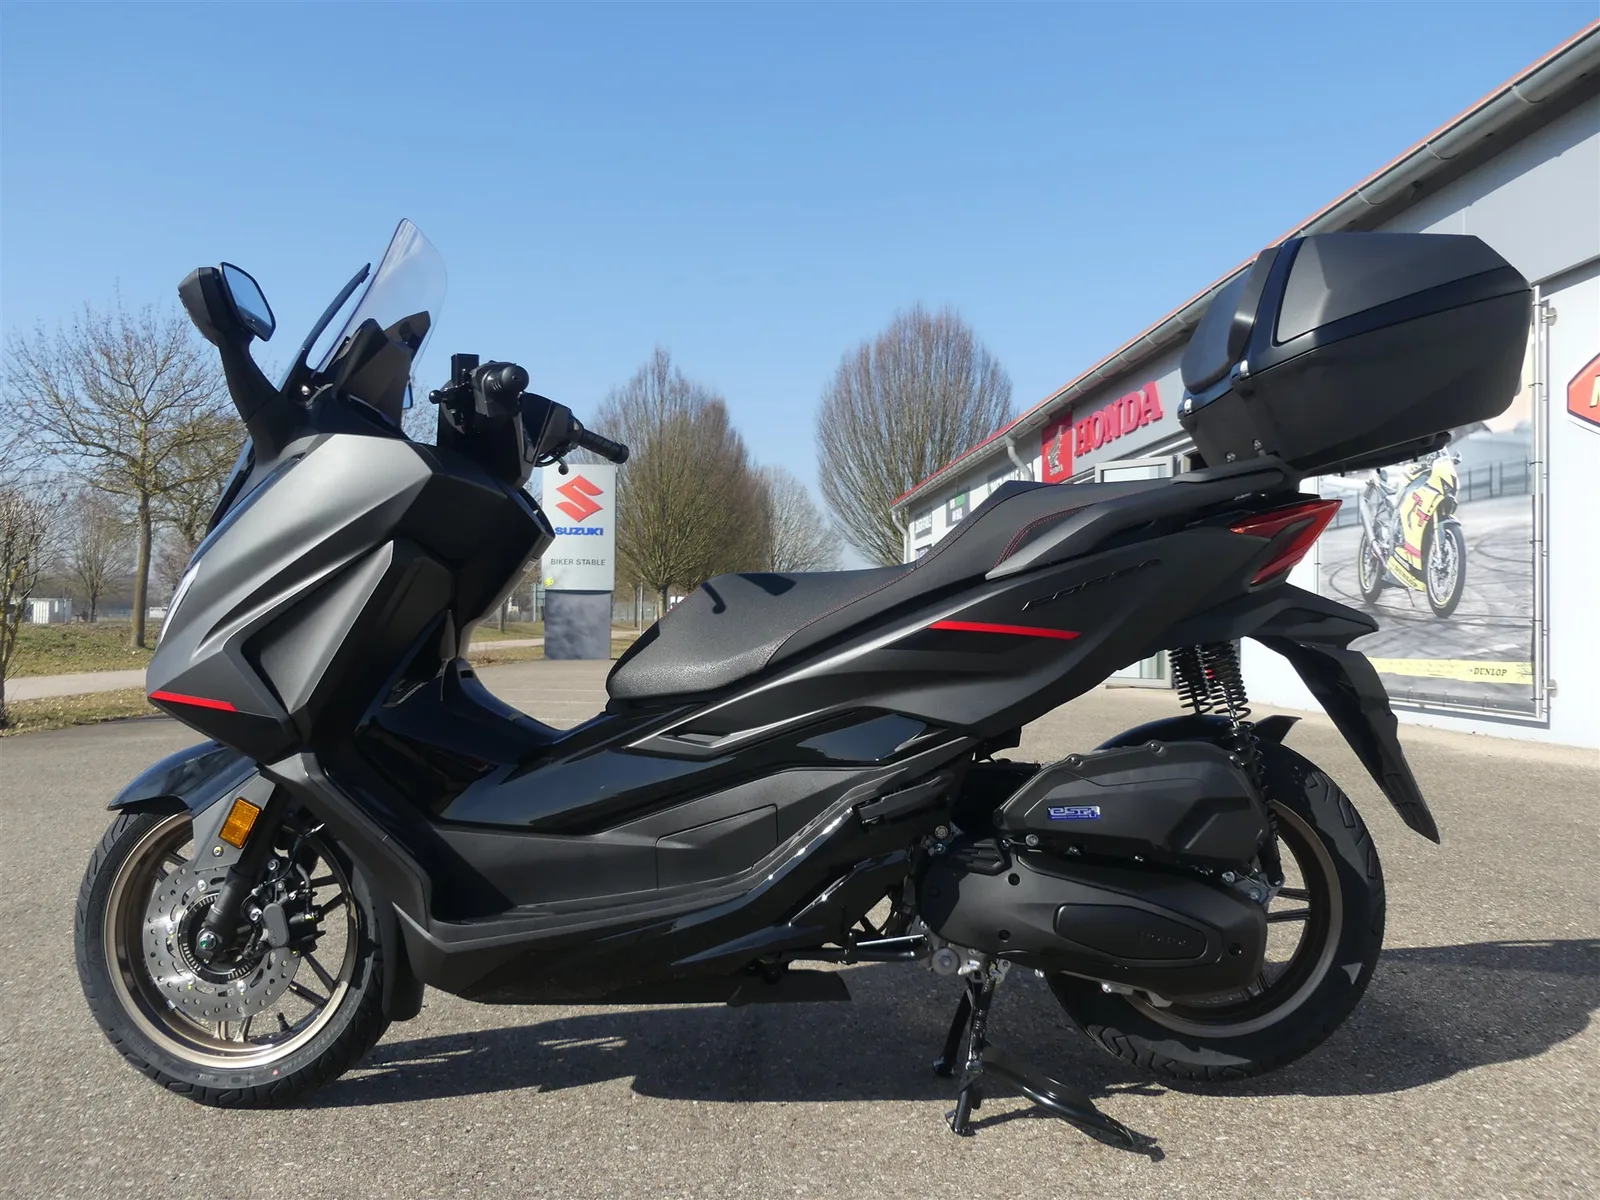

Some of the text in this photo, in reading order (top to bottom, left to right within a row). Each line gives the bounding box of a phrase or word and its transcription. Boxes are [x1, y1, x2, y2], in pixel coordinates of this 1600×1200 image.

[1074, 381, 1163, 458] HONDA
[555, 527, 604, 536] SUZUKI
[551, 558, 606, 566] BIKER STABLE
[1473, 667, 1507, 677] DUNLOP
